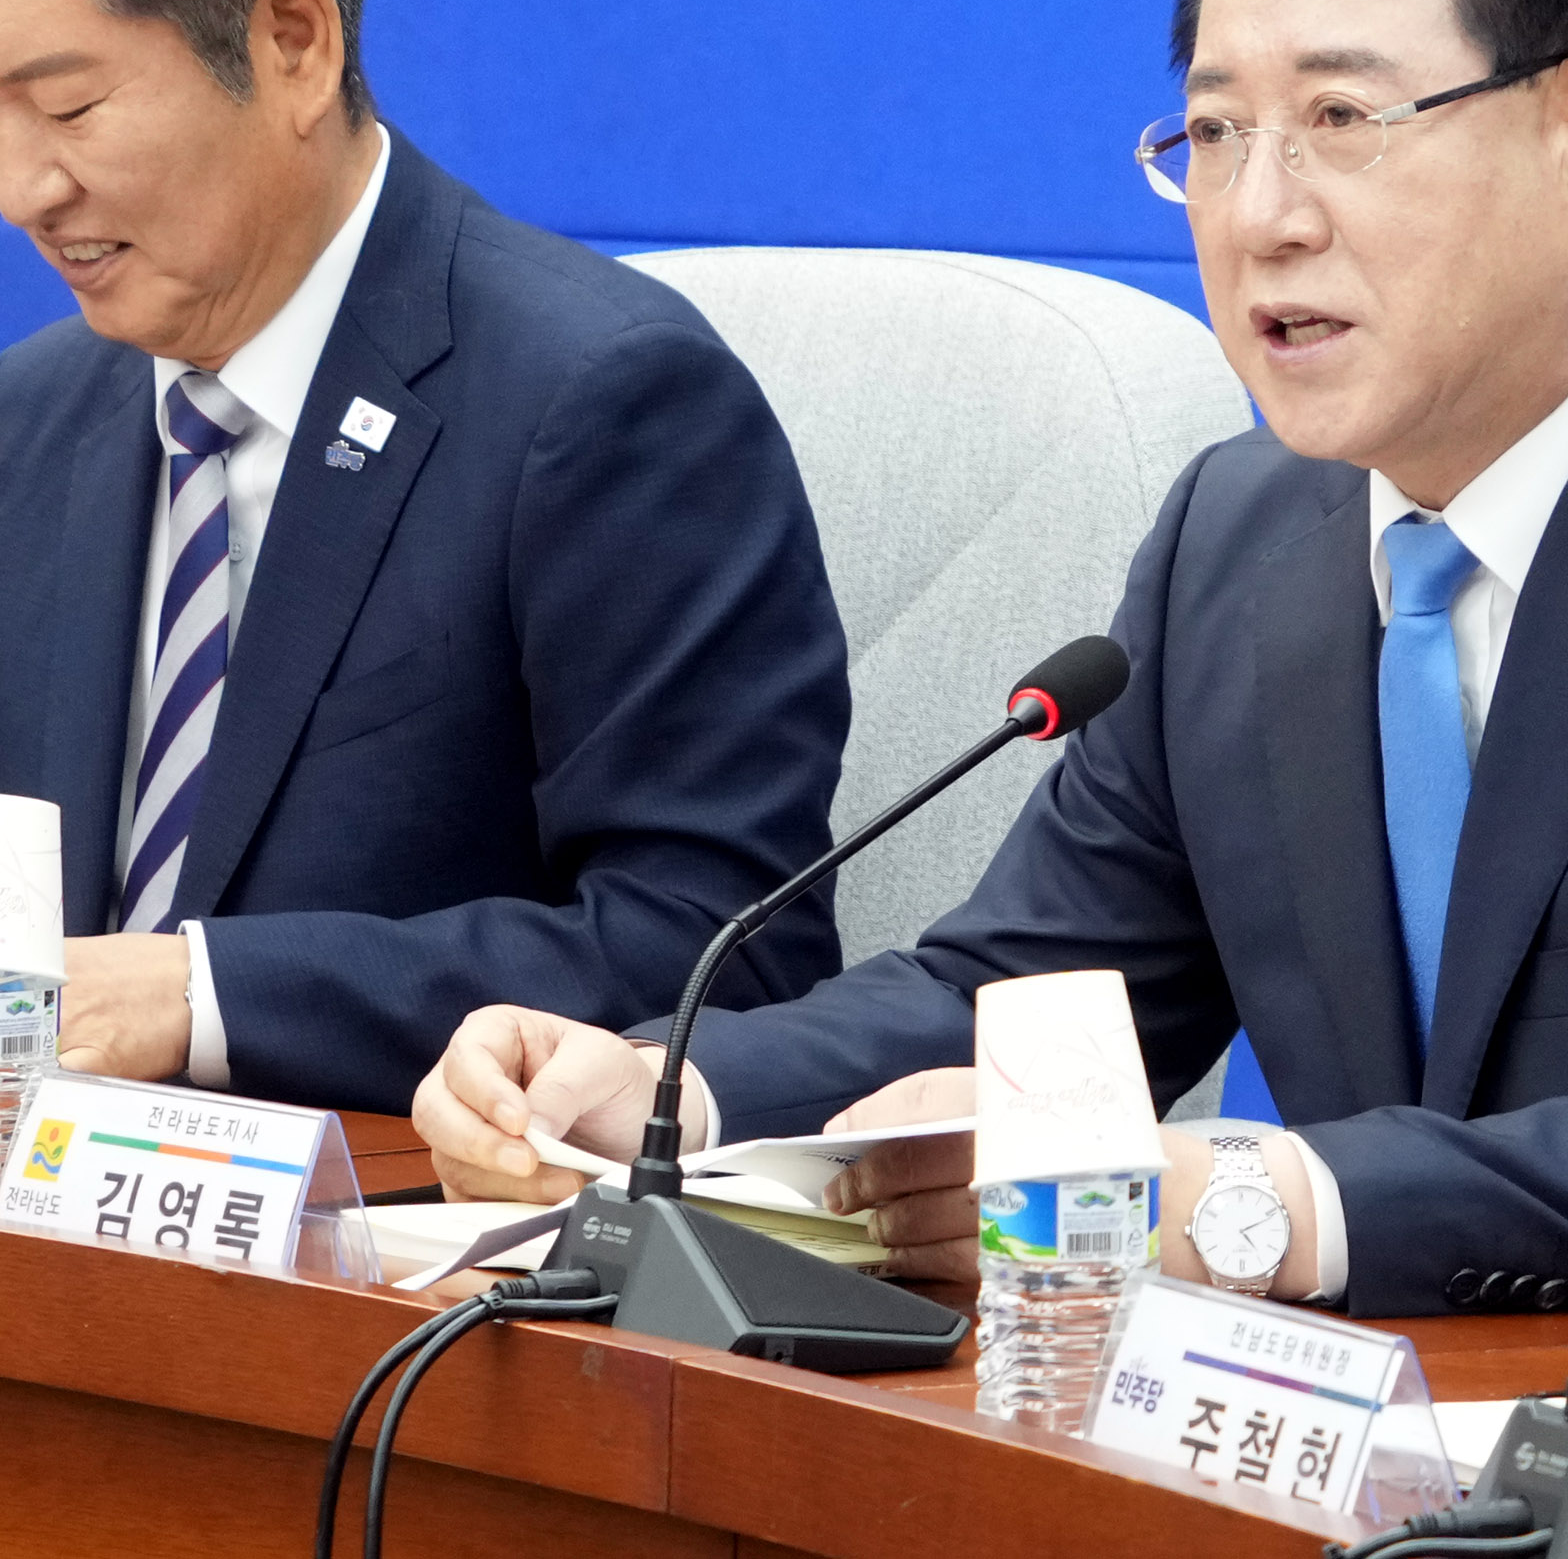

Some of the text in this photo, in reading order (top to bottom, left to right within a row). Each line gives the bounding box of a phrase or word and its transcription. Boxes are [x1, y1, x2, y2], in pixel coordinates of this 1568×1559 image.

[147, 1105, 260, 1145] 전라남도지사
[5, 1186, 63, 1216] 전라남도
[94, 1170, 265, 1261] 김영록
[1111, 1370, 1164, 1414] 민주당
[1179, 1396, 1343, 1506] 주철현
